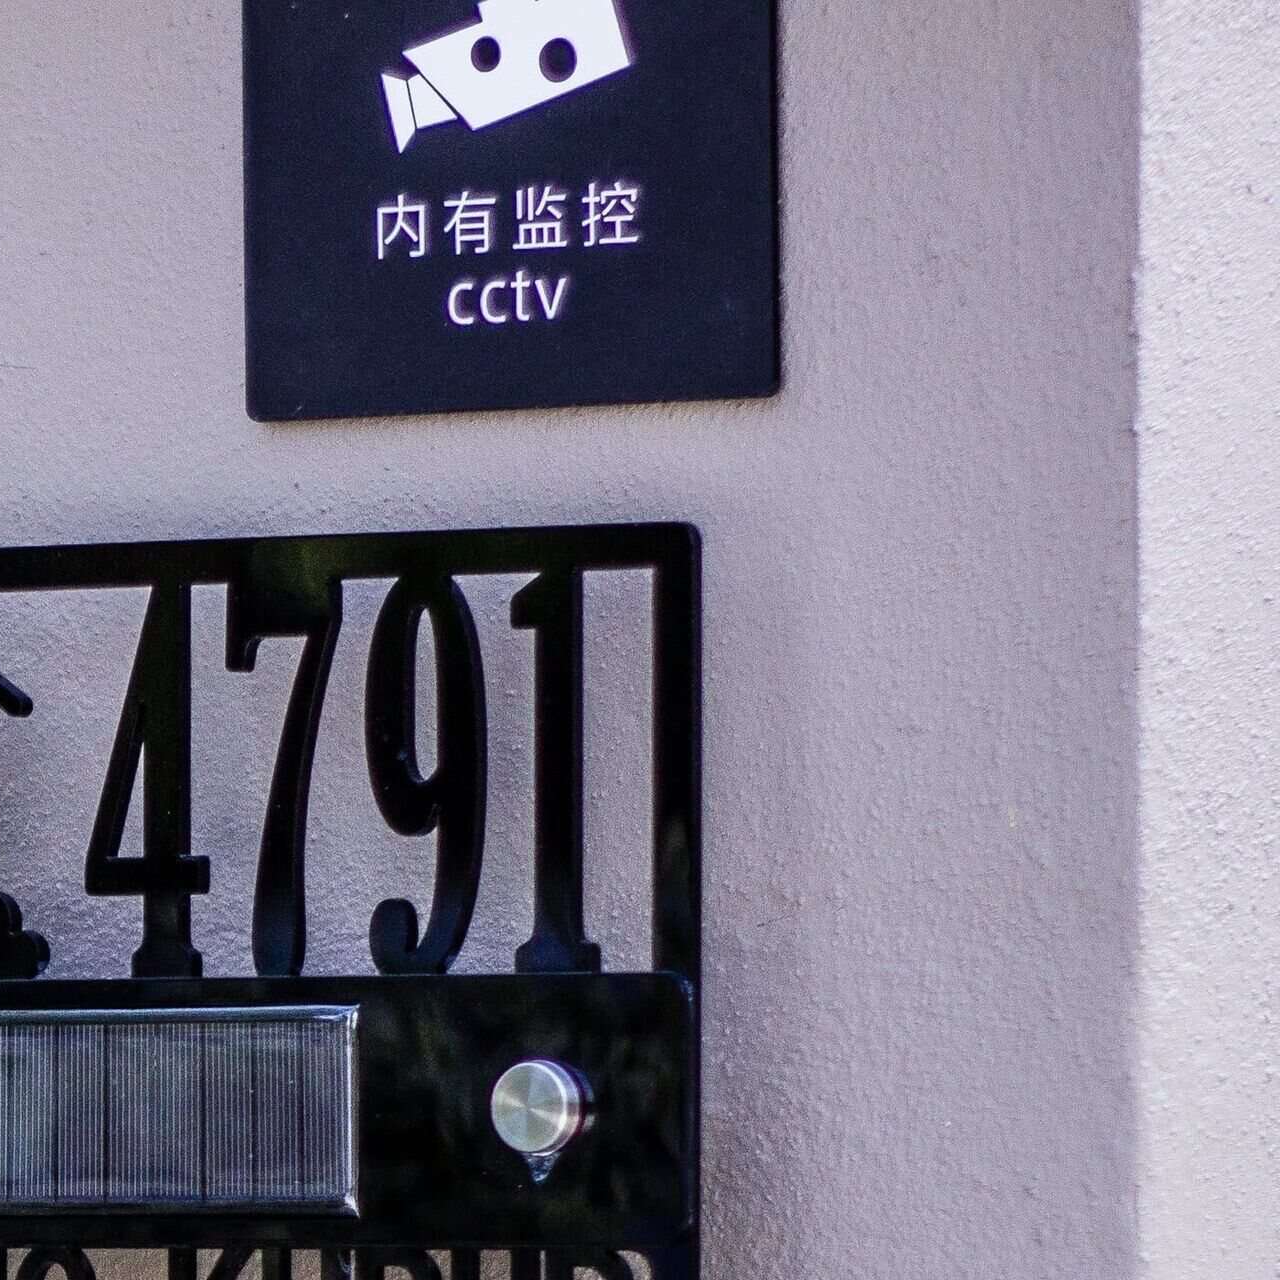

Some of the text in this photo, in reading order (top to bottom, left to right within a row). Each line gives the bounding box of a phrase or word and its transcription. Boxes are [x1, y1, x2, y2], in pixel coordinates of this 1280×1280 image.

[376, 181, 640, 260] 内有监控
[448, 270, 567, 325] cctv
[85, 572, 602, 978] 4791
